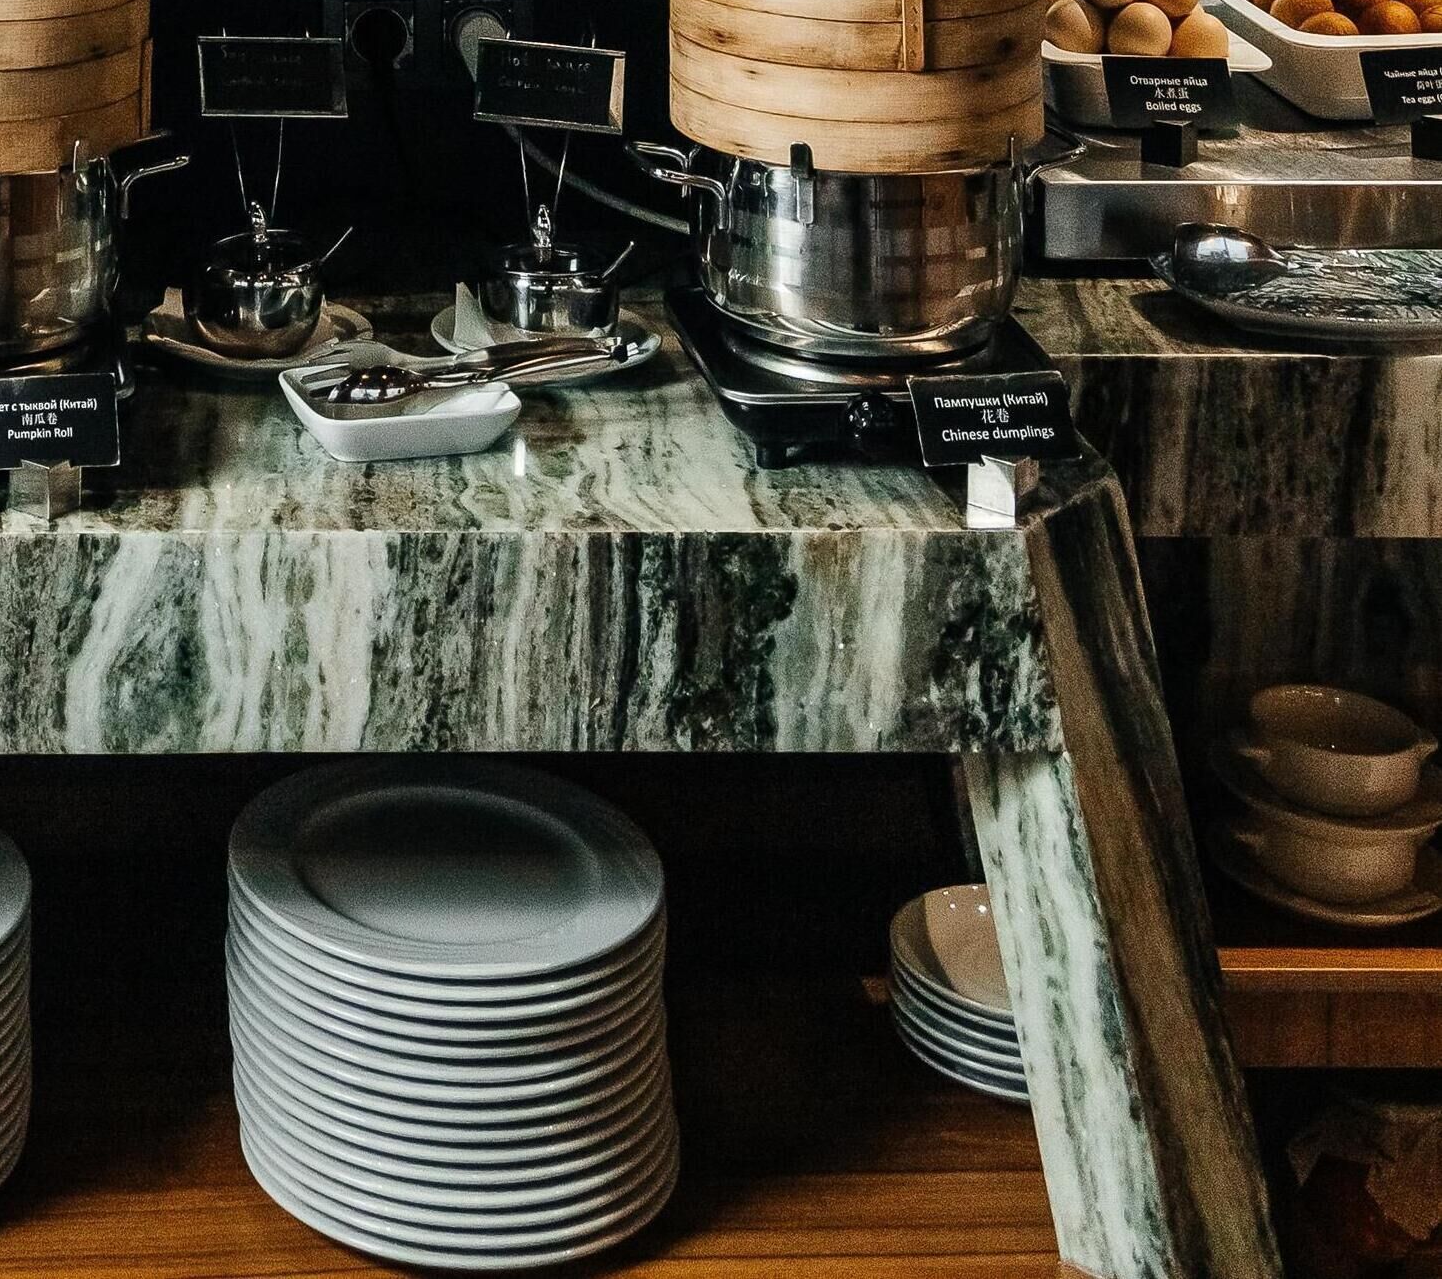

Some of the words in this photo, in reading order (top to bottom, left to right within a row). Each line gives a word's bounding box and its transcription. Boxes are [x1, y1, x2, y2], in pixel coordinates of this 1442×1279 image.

[1130, 75, 1181, 87] Отварные
[1183, 76, 1208, 87] яйца
[1401, 95, 1417, 104] Tea
[1145, 101, 1177, 111] Boiled
[1179, 103, 1203, 114] eggs
[11, 403, 18, 412] с
[18, 399, 58, 412] тыквой
[59, 398, 98, 412] (Китай)
[933, 396, 1001, 410] Пампушки
[1002, 392, 1049, 407] (Китай)
[7, 428, 52, 441] Pumpkin
[54, 427, 73, 439] Roll
[941, 429, 990, 442] Chinese
[992, 425, 1055, 441] dumplings
